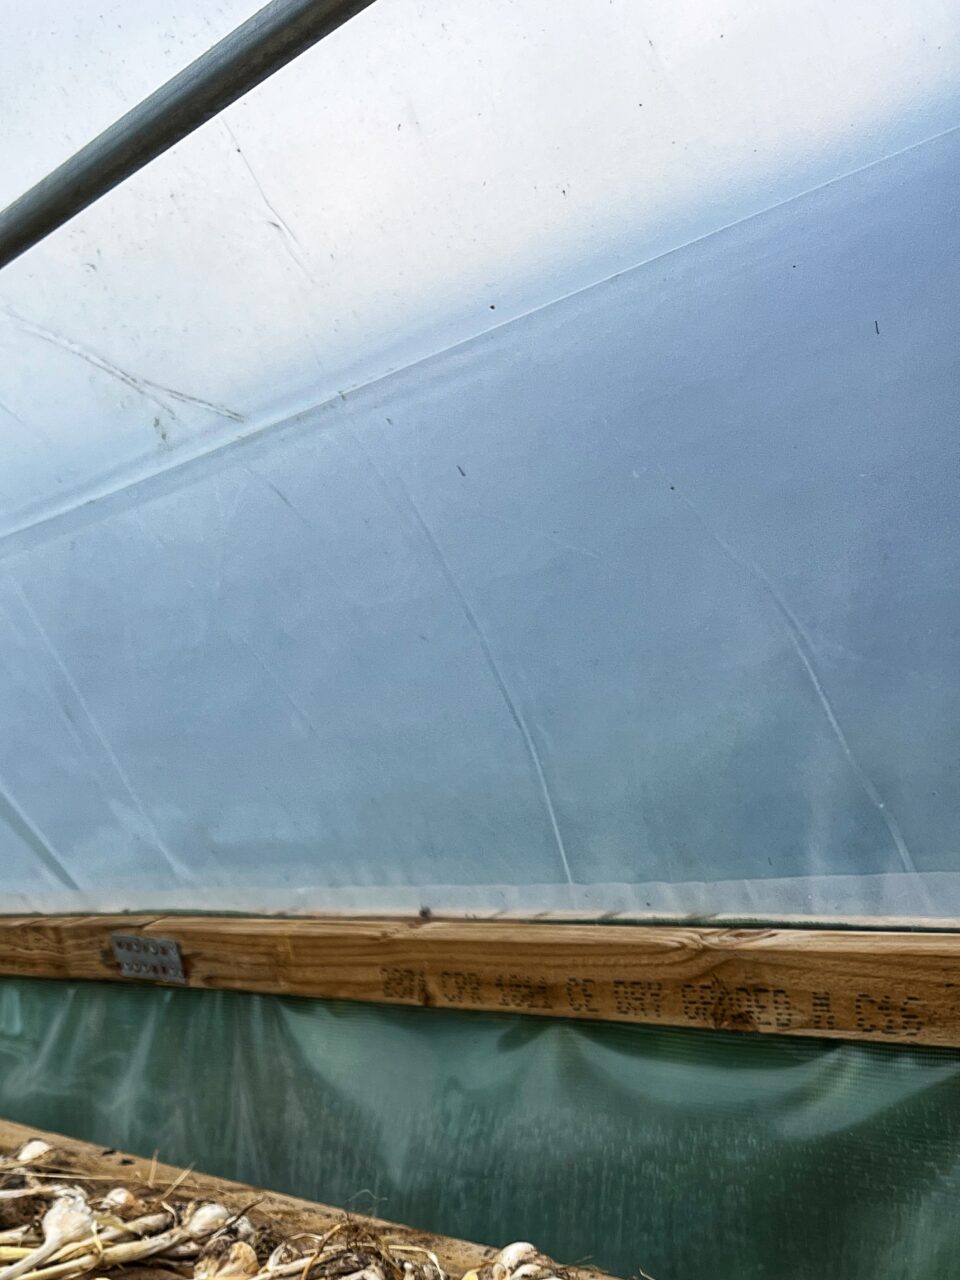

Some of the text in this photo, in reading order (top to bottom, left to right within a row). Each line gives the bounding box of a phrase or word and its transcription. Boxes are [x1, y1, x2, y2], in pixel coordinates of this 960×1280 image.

[566, 977, 598, 1012] CE
[613, 980, 661, 1017] DRY
[681, 984, 792, 1026] GRADED
[855, 993, 925, 1036] C16
